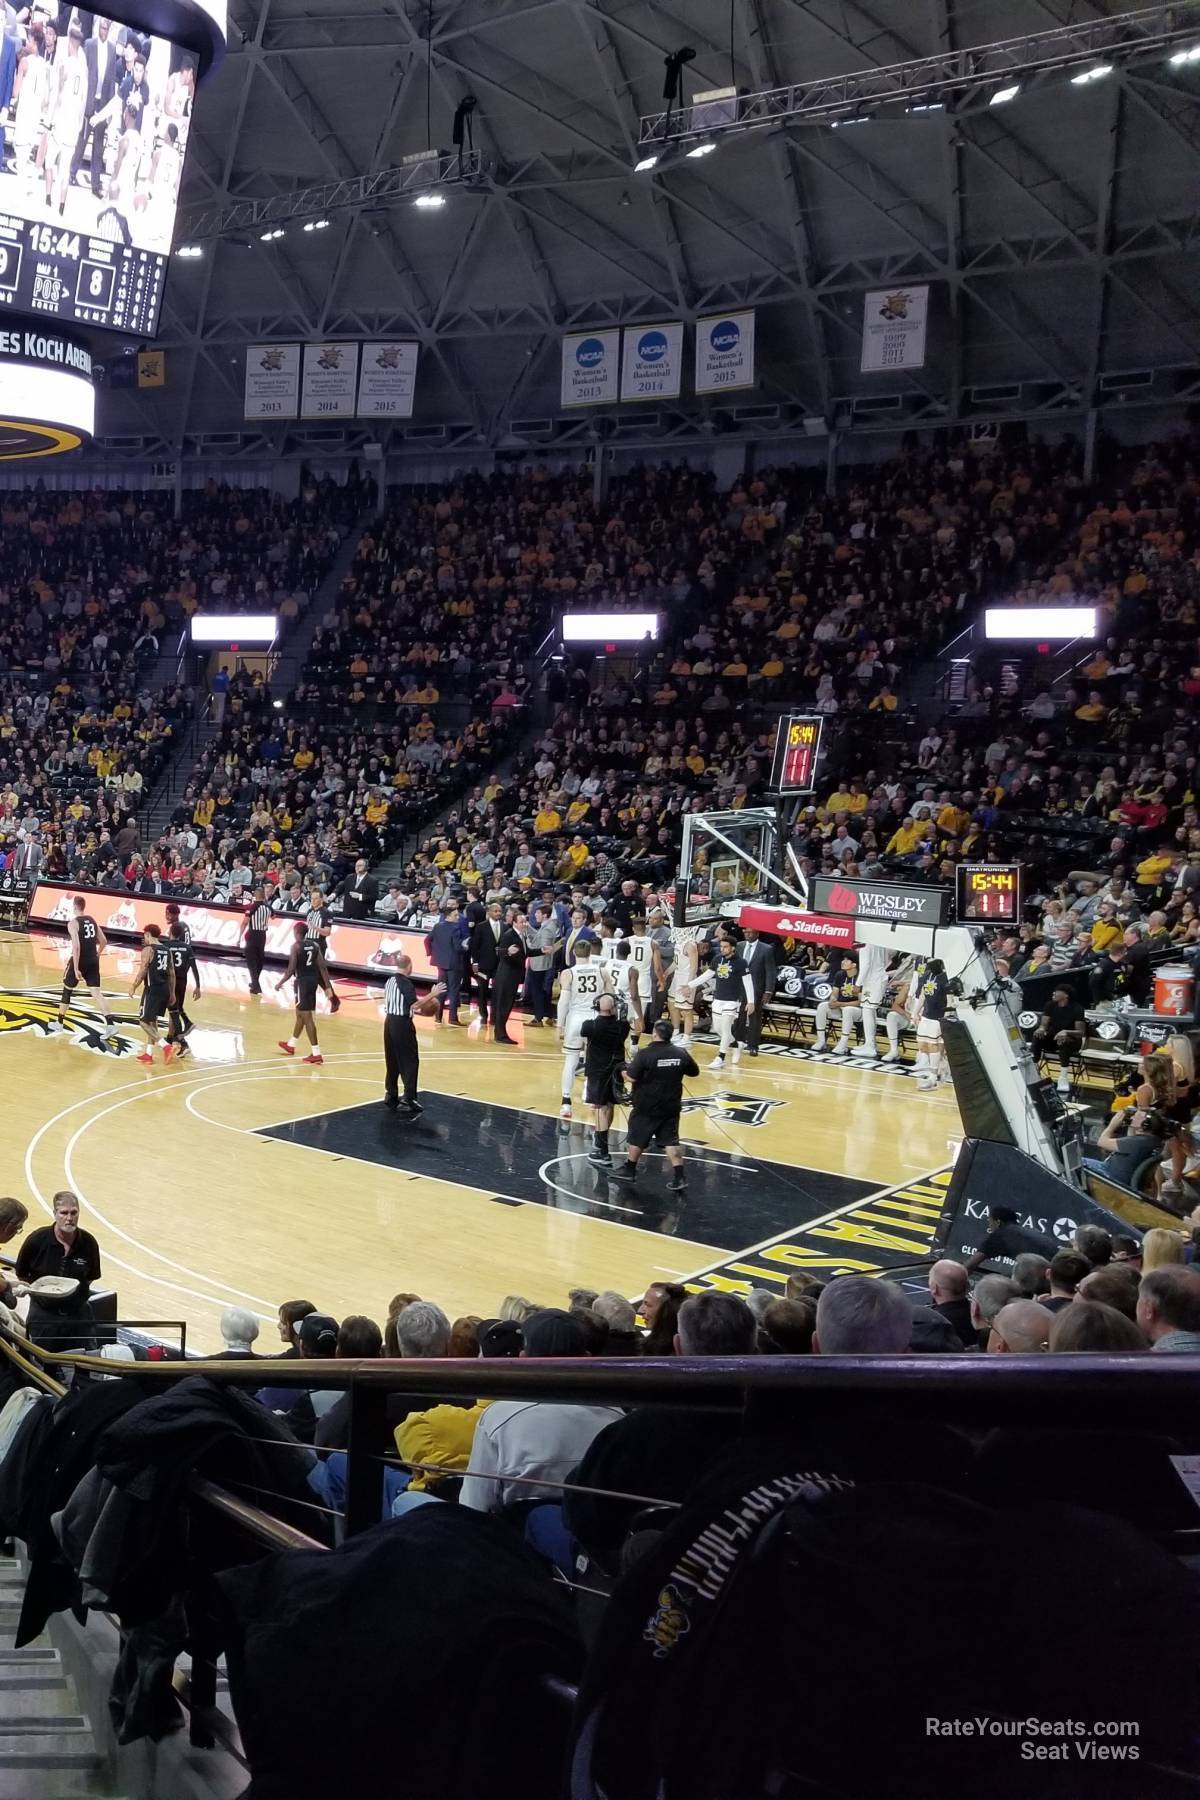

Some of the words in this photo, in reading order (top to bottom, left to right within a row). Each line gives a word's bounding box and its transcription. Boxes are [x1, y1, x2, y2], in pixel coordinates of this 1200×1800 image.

[30, 224, 80, 260] 15:44
[33, 278, 60, 301] POS
[90, 269, 103, 296] 8
[100, 312, 106, 323] 2
[713, 334, 740, 346] NCAA
[24, 333, 63, 363] KOCH
[641, 345, 667, 355] NCAA
[579, 352, 605, 361] NCAA
[709, 352, 742, 362] Women's
[635, 361, 670, 370] Women's
[706, 358, 744, 371] Basketball
[574, 368, 607, 377] Women's
[633, 369, 670, 379] Basketball
[713, 371, 736, 382] 2015
[572, 375, 607, 385] Basketball
[638, 381, 663, 391] 2014
[576, 387, 601, 397] 2013
[261, 402, 282, 412] 2013
[317, 402, 338, 411] 2014
[374, 401, 396, 411] 2015
[790, 725, 814, 745] 15:44
[790, 750, 808, 782] 11
[972, 874, 1012, 890] 15:44
[858, 892, 926, 913] WESLEY
[983, 894, 1005, 913] 11
[857, 905, 908, 920] Healthcare
[83, 923, 96, 939] 33
[174, 952, 183, 967] 3
[306, 951, 313, 967] 2
[635, 946, 644, 962] 0
[156, 954, 168, 971] 34
[578, 975, 597, 994] 33
[611, 970, 620, 987] 5
[657, 1058, 681, 1067] ESPN
